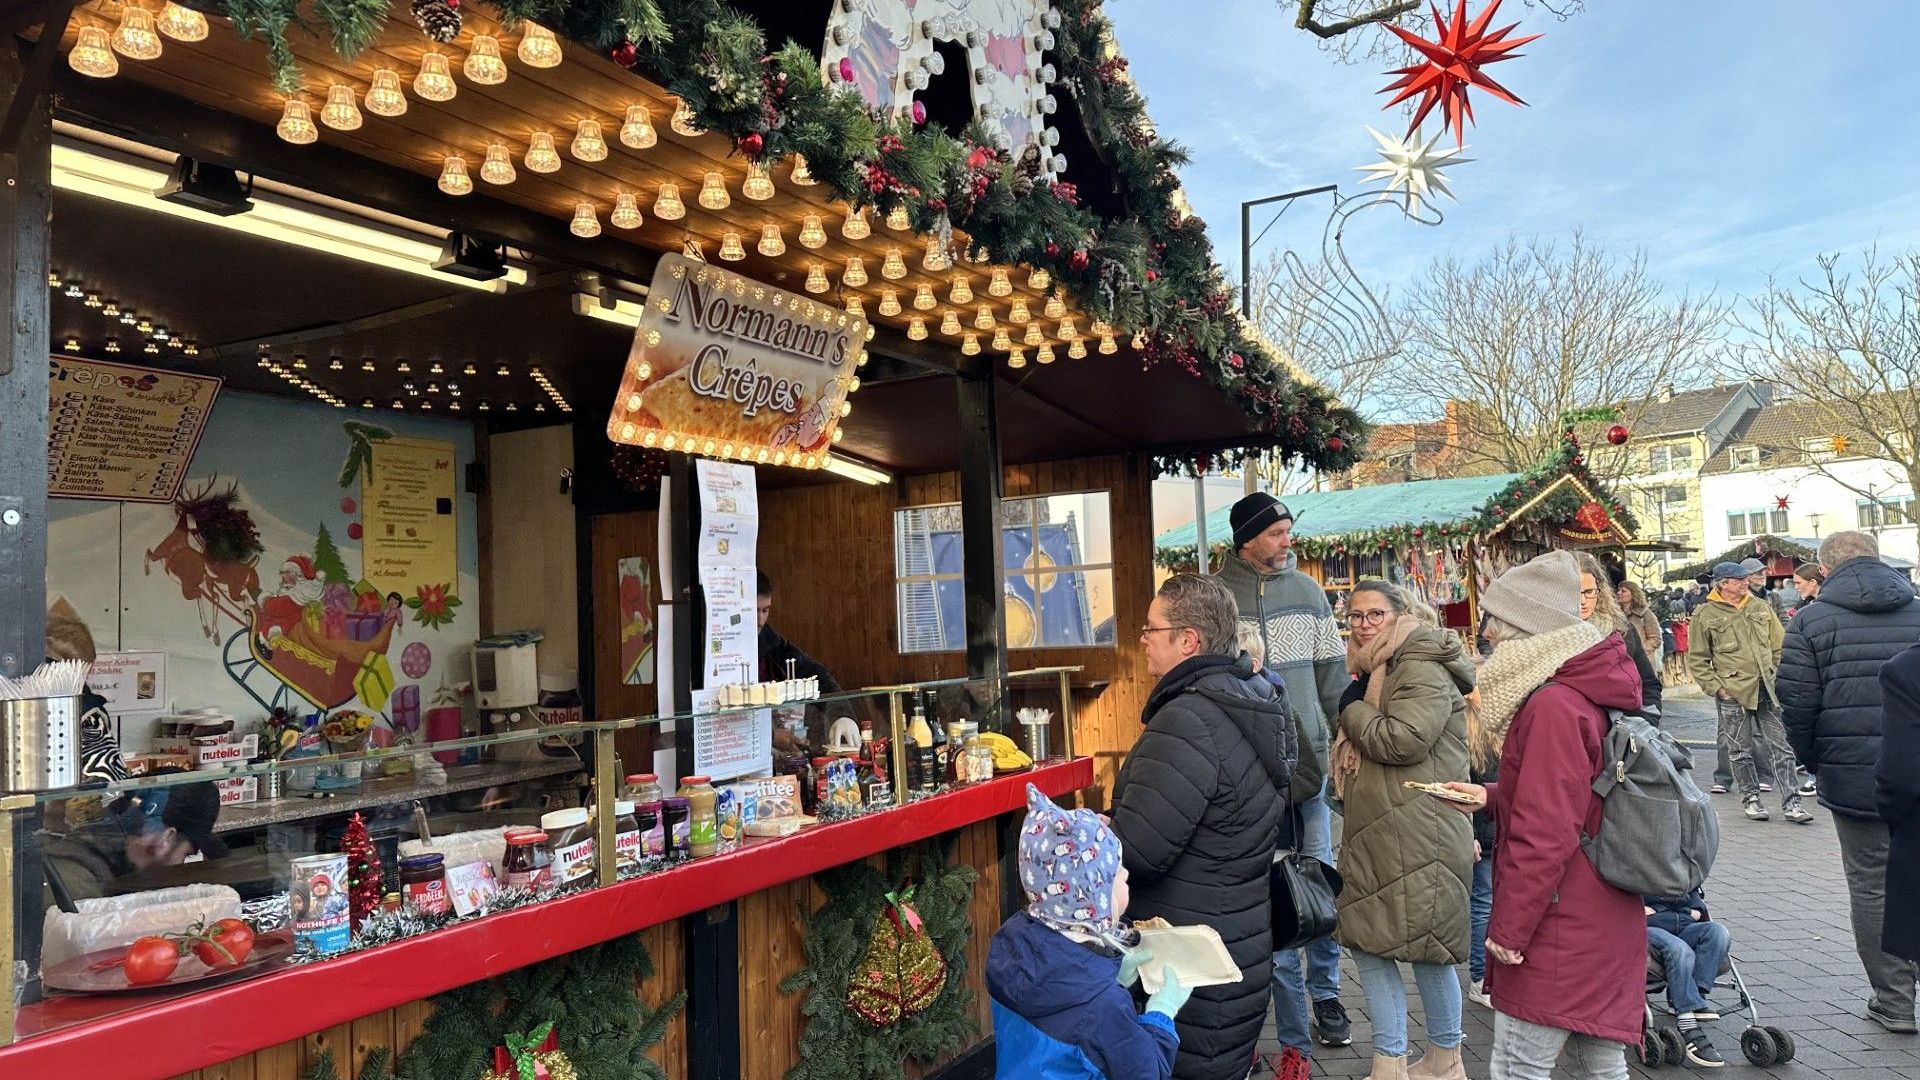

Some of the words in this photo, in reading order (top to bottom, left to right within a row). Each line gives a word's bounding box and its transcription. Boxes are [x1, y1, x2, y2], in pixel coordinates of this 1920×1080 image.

[689, 343, 804, 417] Crêpes
[86, 410, 144, 423] Käse-Salami
[75, 439, 120, 451] Camembert
[61, 475, 105, 485] Amaretto
[202, 748, 241, 761] nutella
